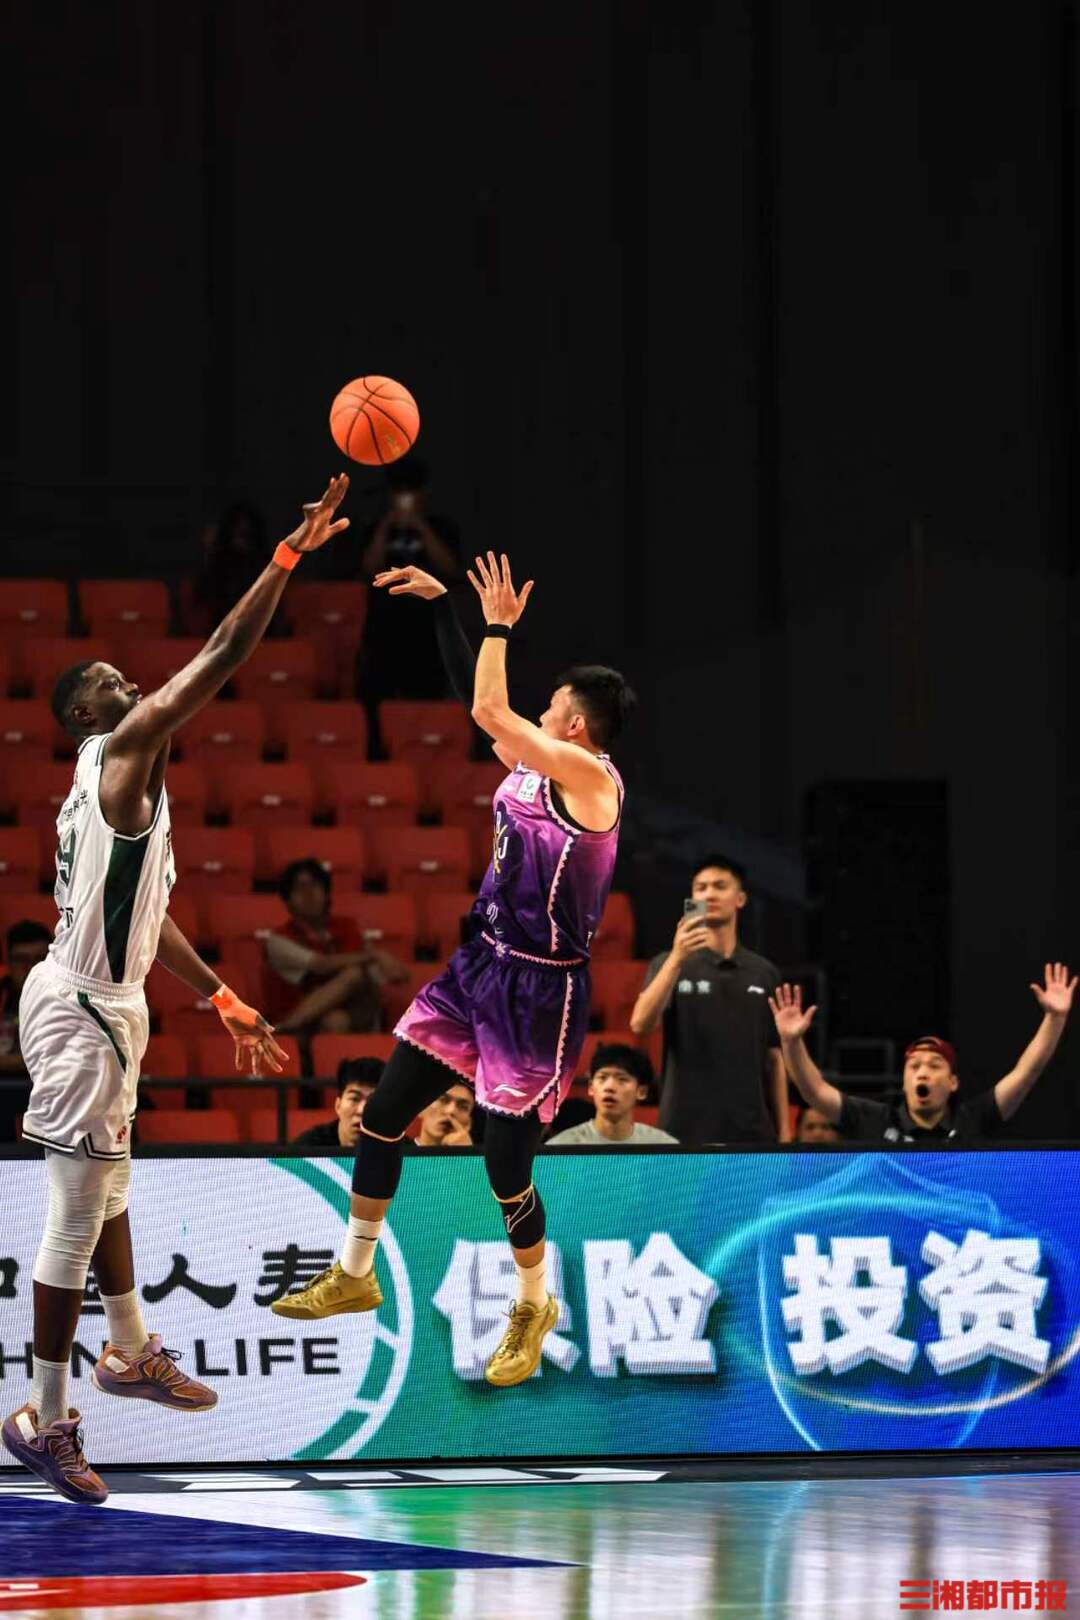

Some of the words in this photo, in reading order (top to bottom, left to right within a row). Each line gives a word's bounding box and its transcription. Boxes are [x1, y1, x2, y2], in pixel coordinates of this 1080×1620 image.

[0, 1243, 335, 1315] 人寿
[432, 1232, 721, 1381] 保险
[781, 1230, 1050, 1376] 投资
[194, 1337, 341, 1377] LIFE
